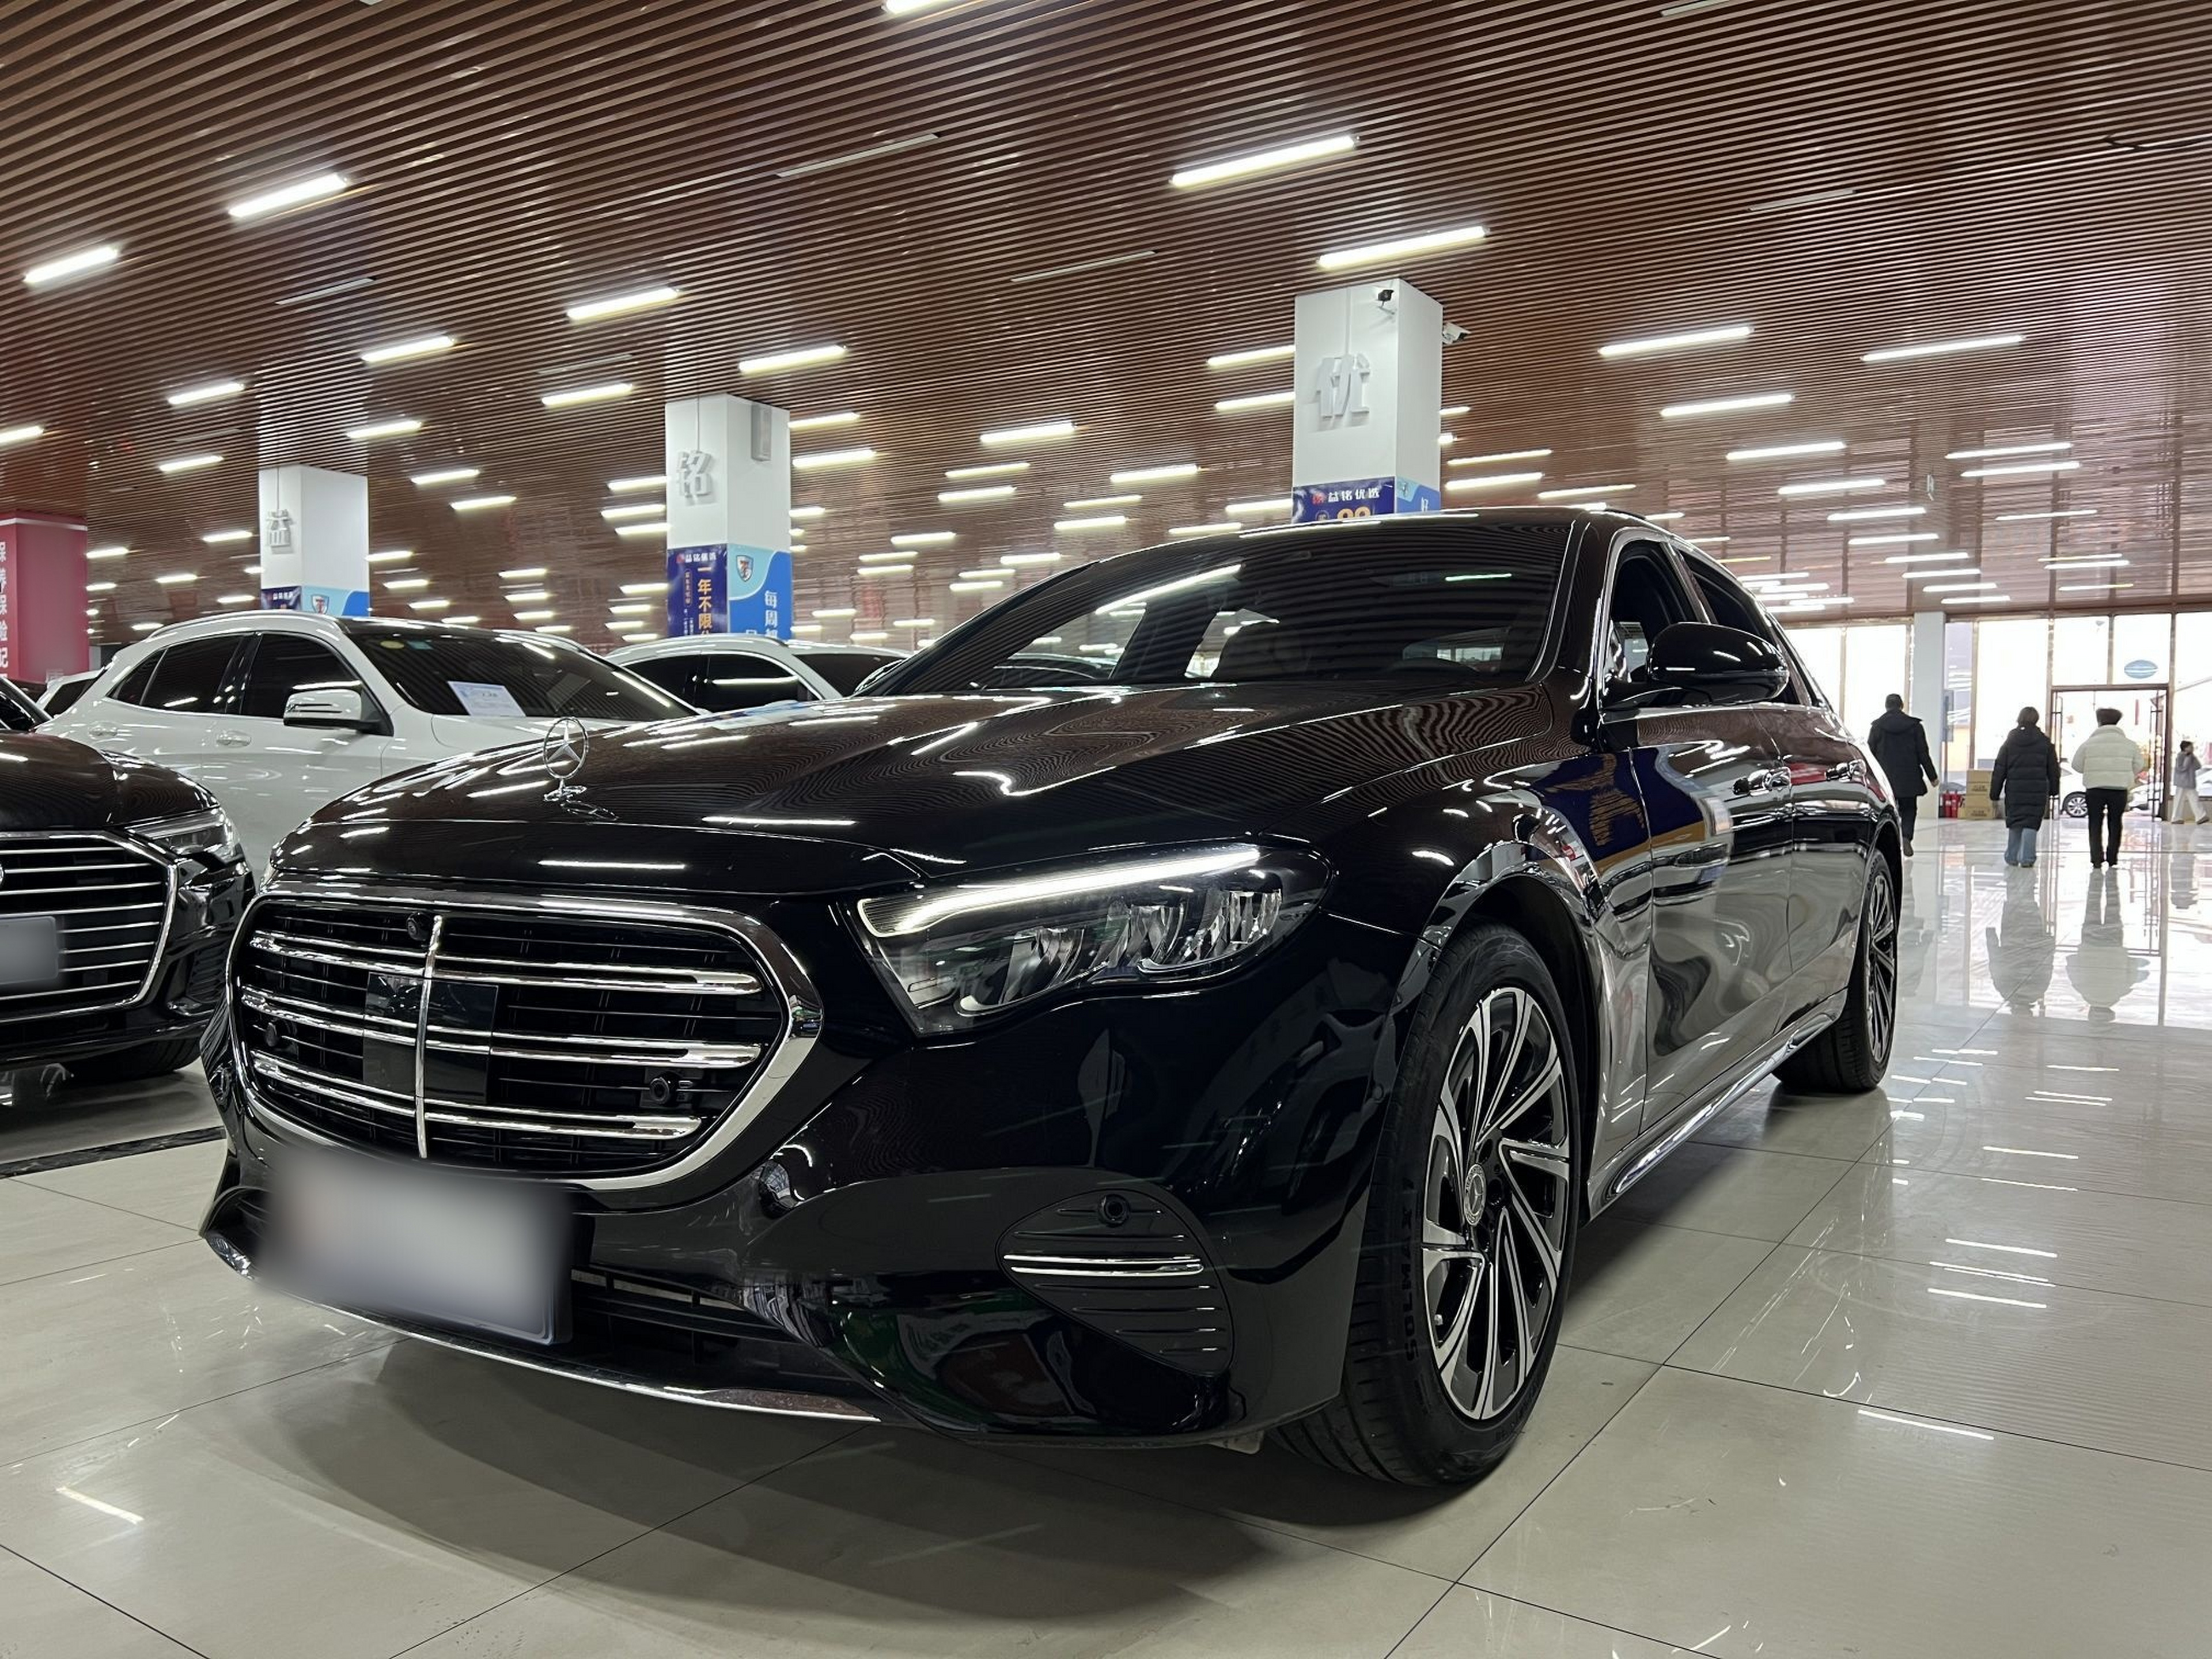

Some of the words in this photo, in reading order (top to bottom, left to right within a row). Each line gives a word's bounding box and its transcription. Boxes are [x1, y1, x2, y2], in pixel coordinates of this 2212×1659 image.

[1316, 353, 1371, 419] 优
[677, 450, 713, 498] 铭
[697, 566, 713, 635] 一年不限
